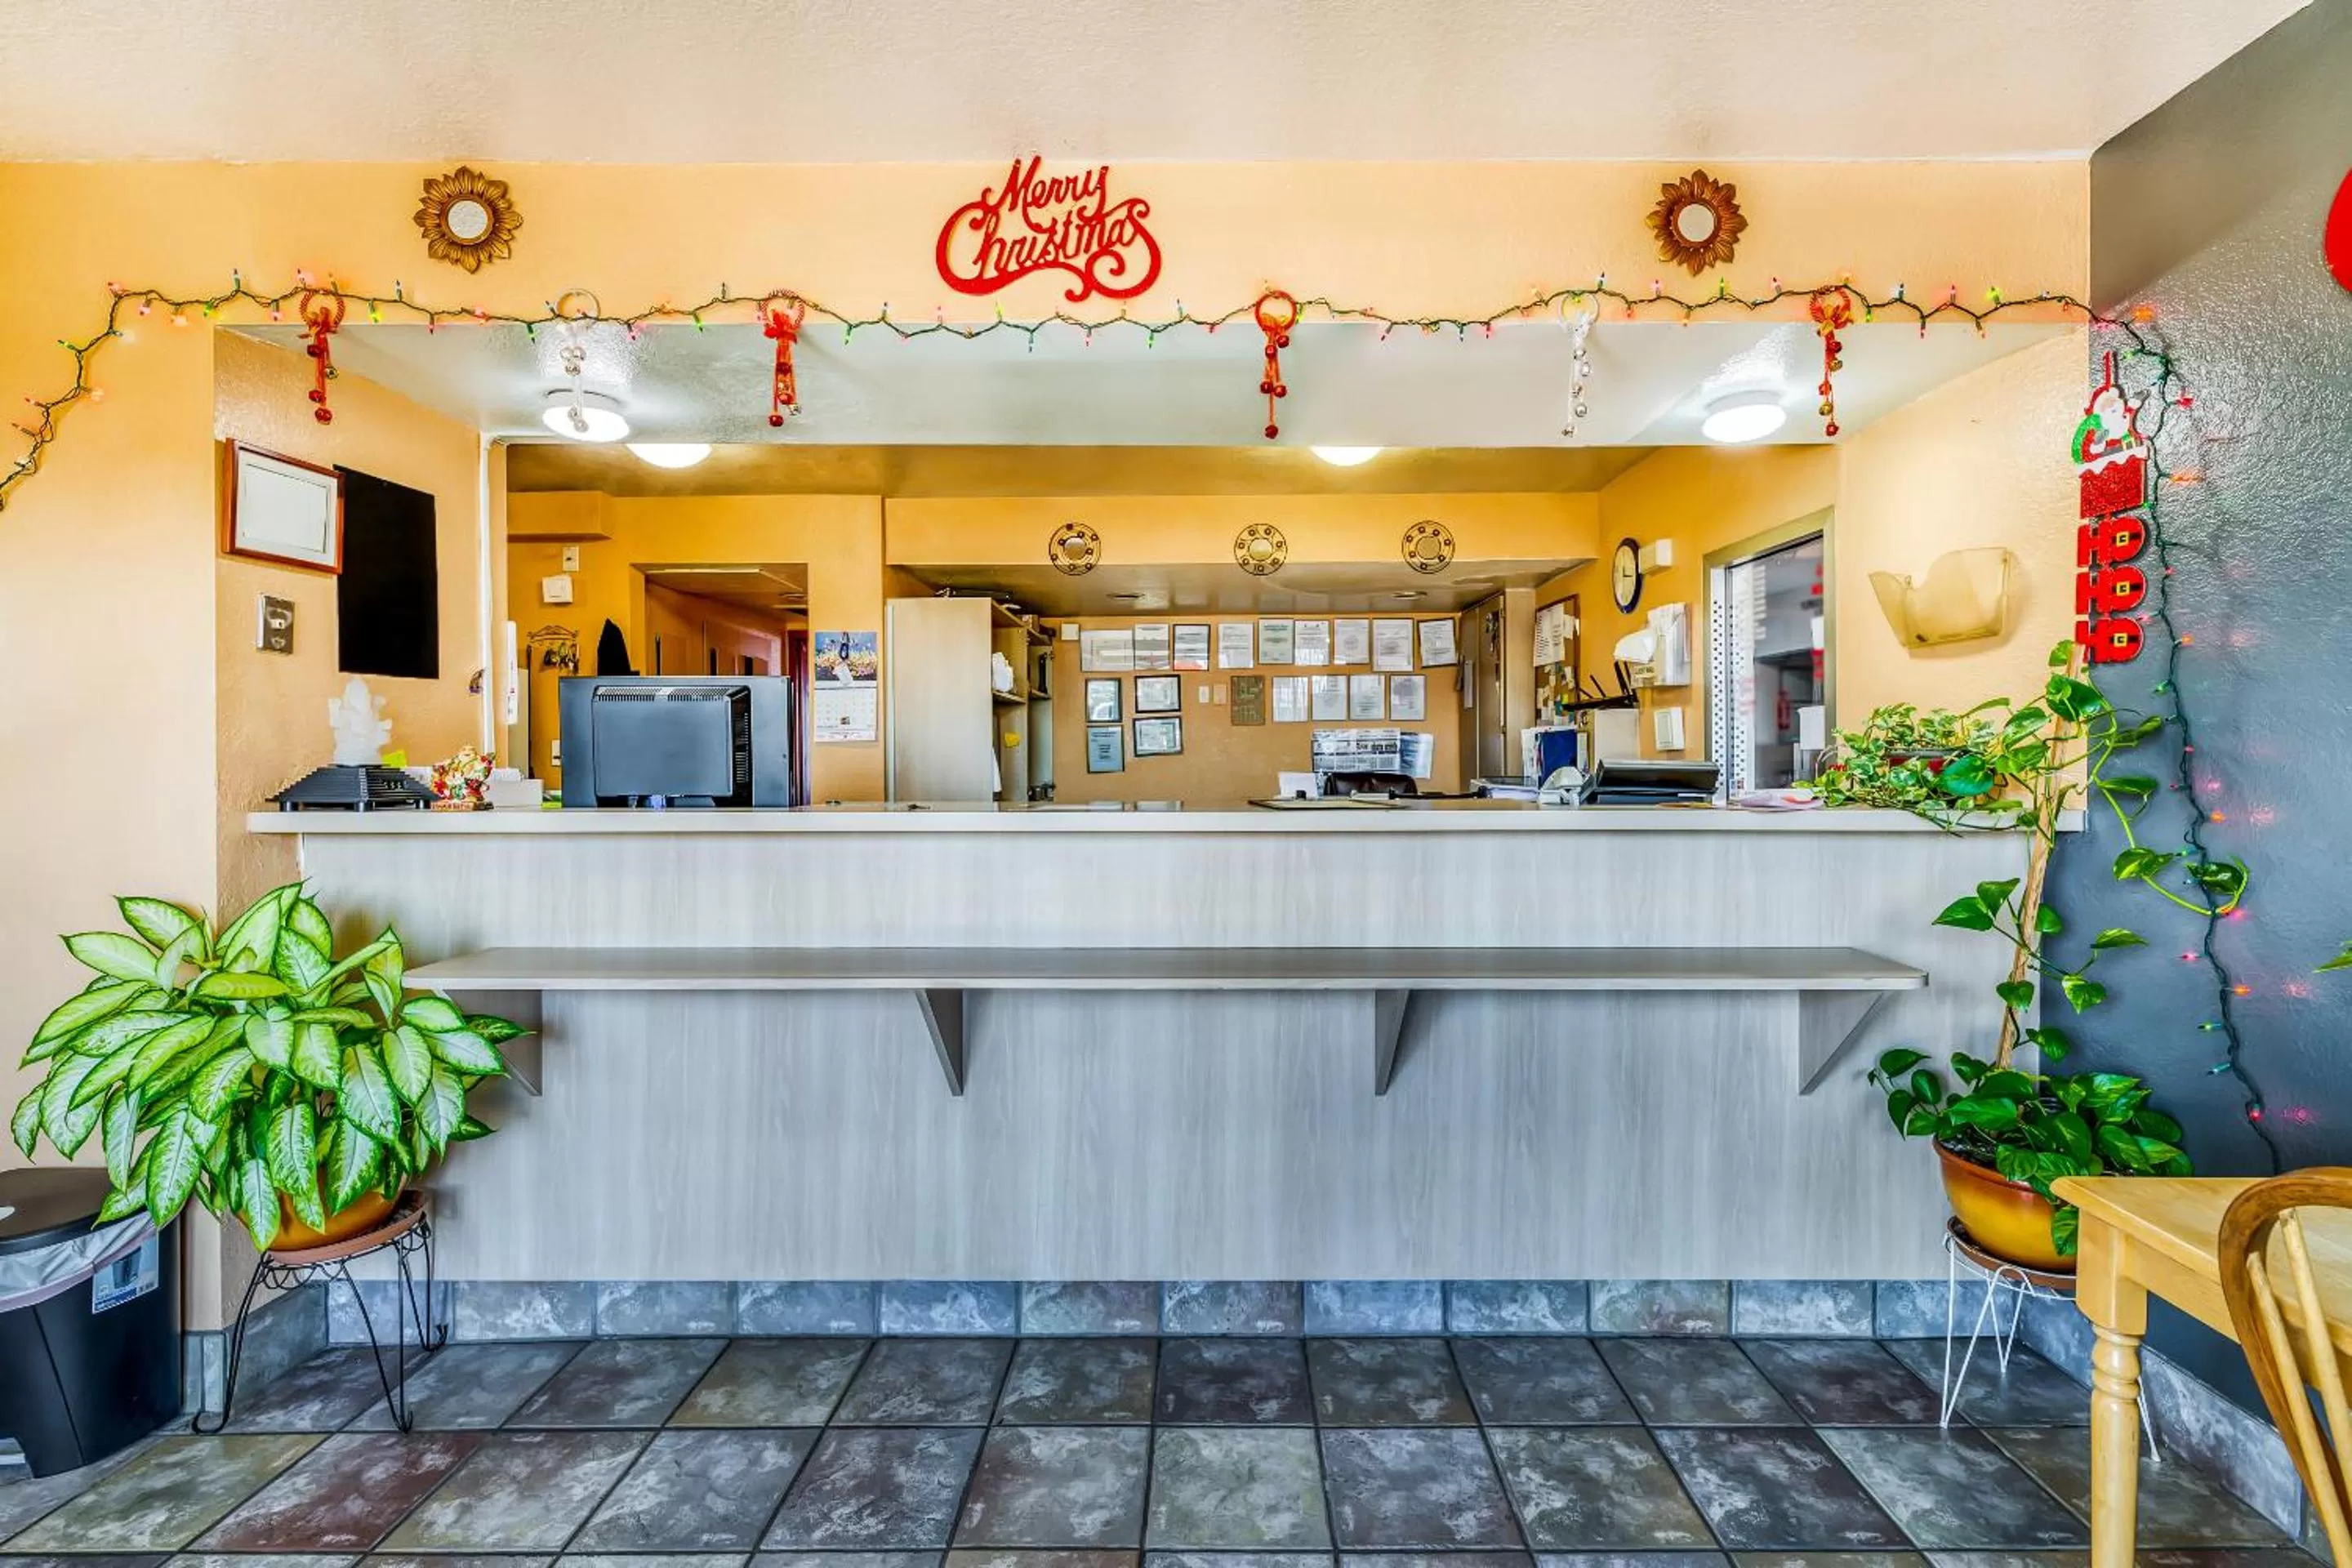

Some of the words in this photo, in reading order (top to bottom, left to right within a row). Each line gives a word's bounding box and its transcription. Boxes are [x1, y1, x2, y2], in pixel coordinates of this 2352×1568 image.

[981, 155, 1109, 233] Merry
[936, 198, 1161, 302] Christmas
[2077, 516, 2145, 567] HO
[2075, 565, 2146, 615] HO
